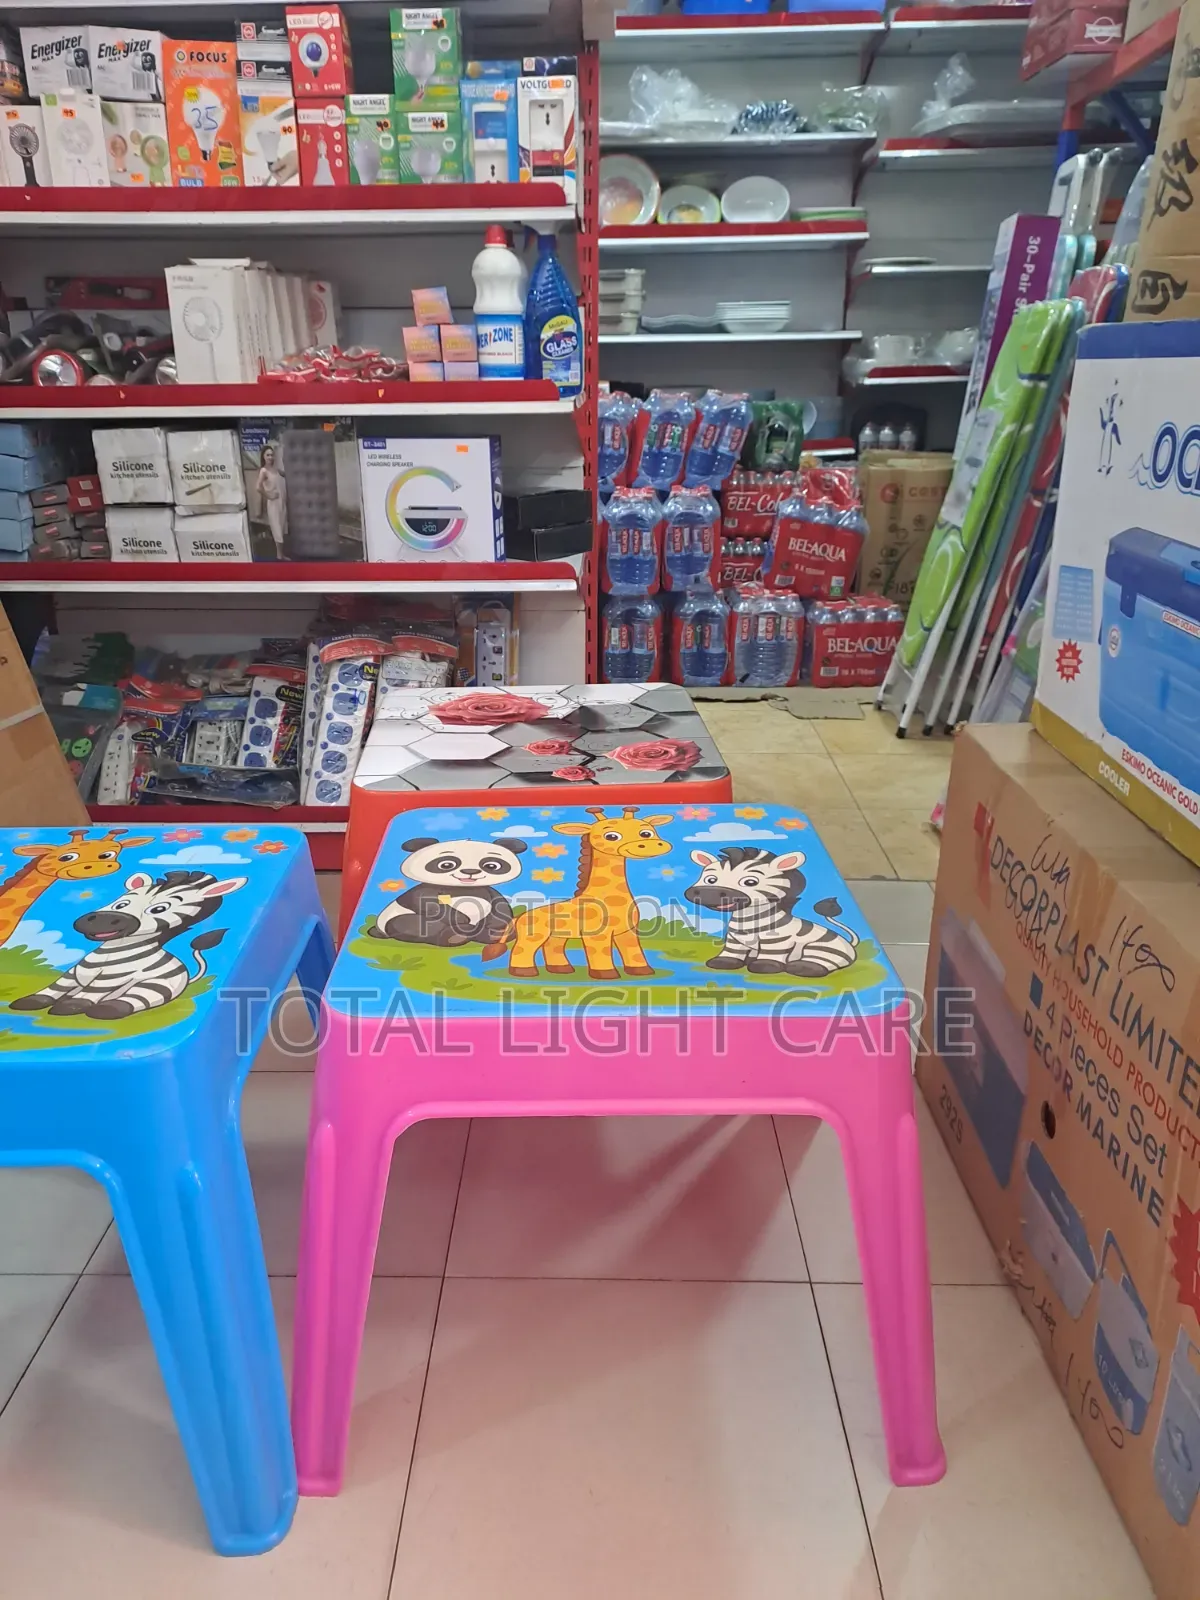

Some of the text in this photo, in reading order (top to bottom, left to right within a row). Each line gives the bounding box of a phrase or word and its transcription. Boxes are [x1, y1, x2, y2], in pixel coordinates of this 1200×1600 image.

[31, 35, 82, 59] Energizer
[98, 39, 151, 59] Enegizer
[190, 52, 227, 63] FOCUS
[520, 80, 571, 89] VOLTGD
[191, 106, 218, 131] 35
[180, 178, 203, 186] BULB
[1018, 235, 1041, 293] 30-Pair
[493, 328, 513, 343] ZONE
[546, 336, 577, 352] GLASS
[112, 461, 154, 472] Silicone
[183, 463, 226, 473] Silicone
[1150, 421, 1200, 497] OC
[180, 473, 204, 481] kitchen
[727, 492, 784, 513] BEL-Col
[122, 537, 162, 548] Silicone
[192, 540, 234, 550] Silicone
[788, 537, 846, 562] BEL-AQUA
[723, 566, 764, 583] BEL-C
[828, 636, 899, 655] BEL-AQUA
[1098, 761, 1130, 796] COOLER
[1122, 748, 1199, 815] ESKIMO OCEANIC GOLD
[990, 835, 1109, 998] DECORPLAST
[1109, 978, 1200, 1120] LIMITE
[1015, 920, 1052, 977] QUALITY
[1052, 968, 1124, 1070] HOUSEHOLD
[1126, 1061, 1200, 1169] PRODUCT
[1046, 1002, 1168, 1178] 4 Pieces Set
[1023, 1009, 1074, 1103] DECOR
[1076, 1091, 1165, 1228] MARINE
